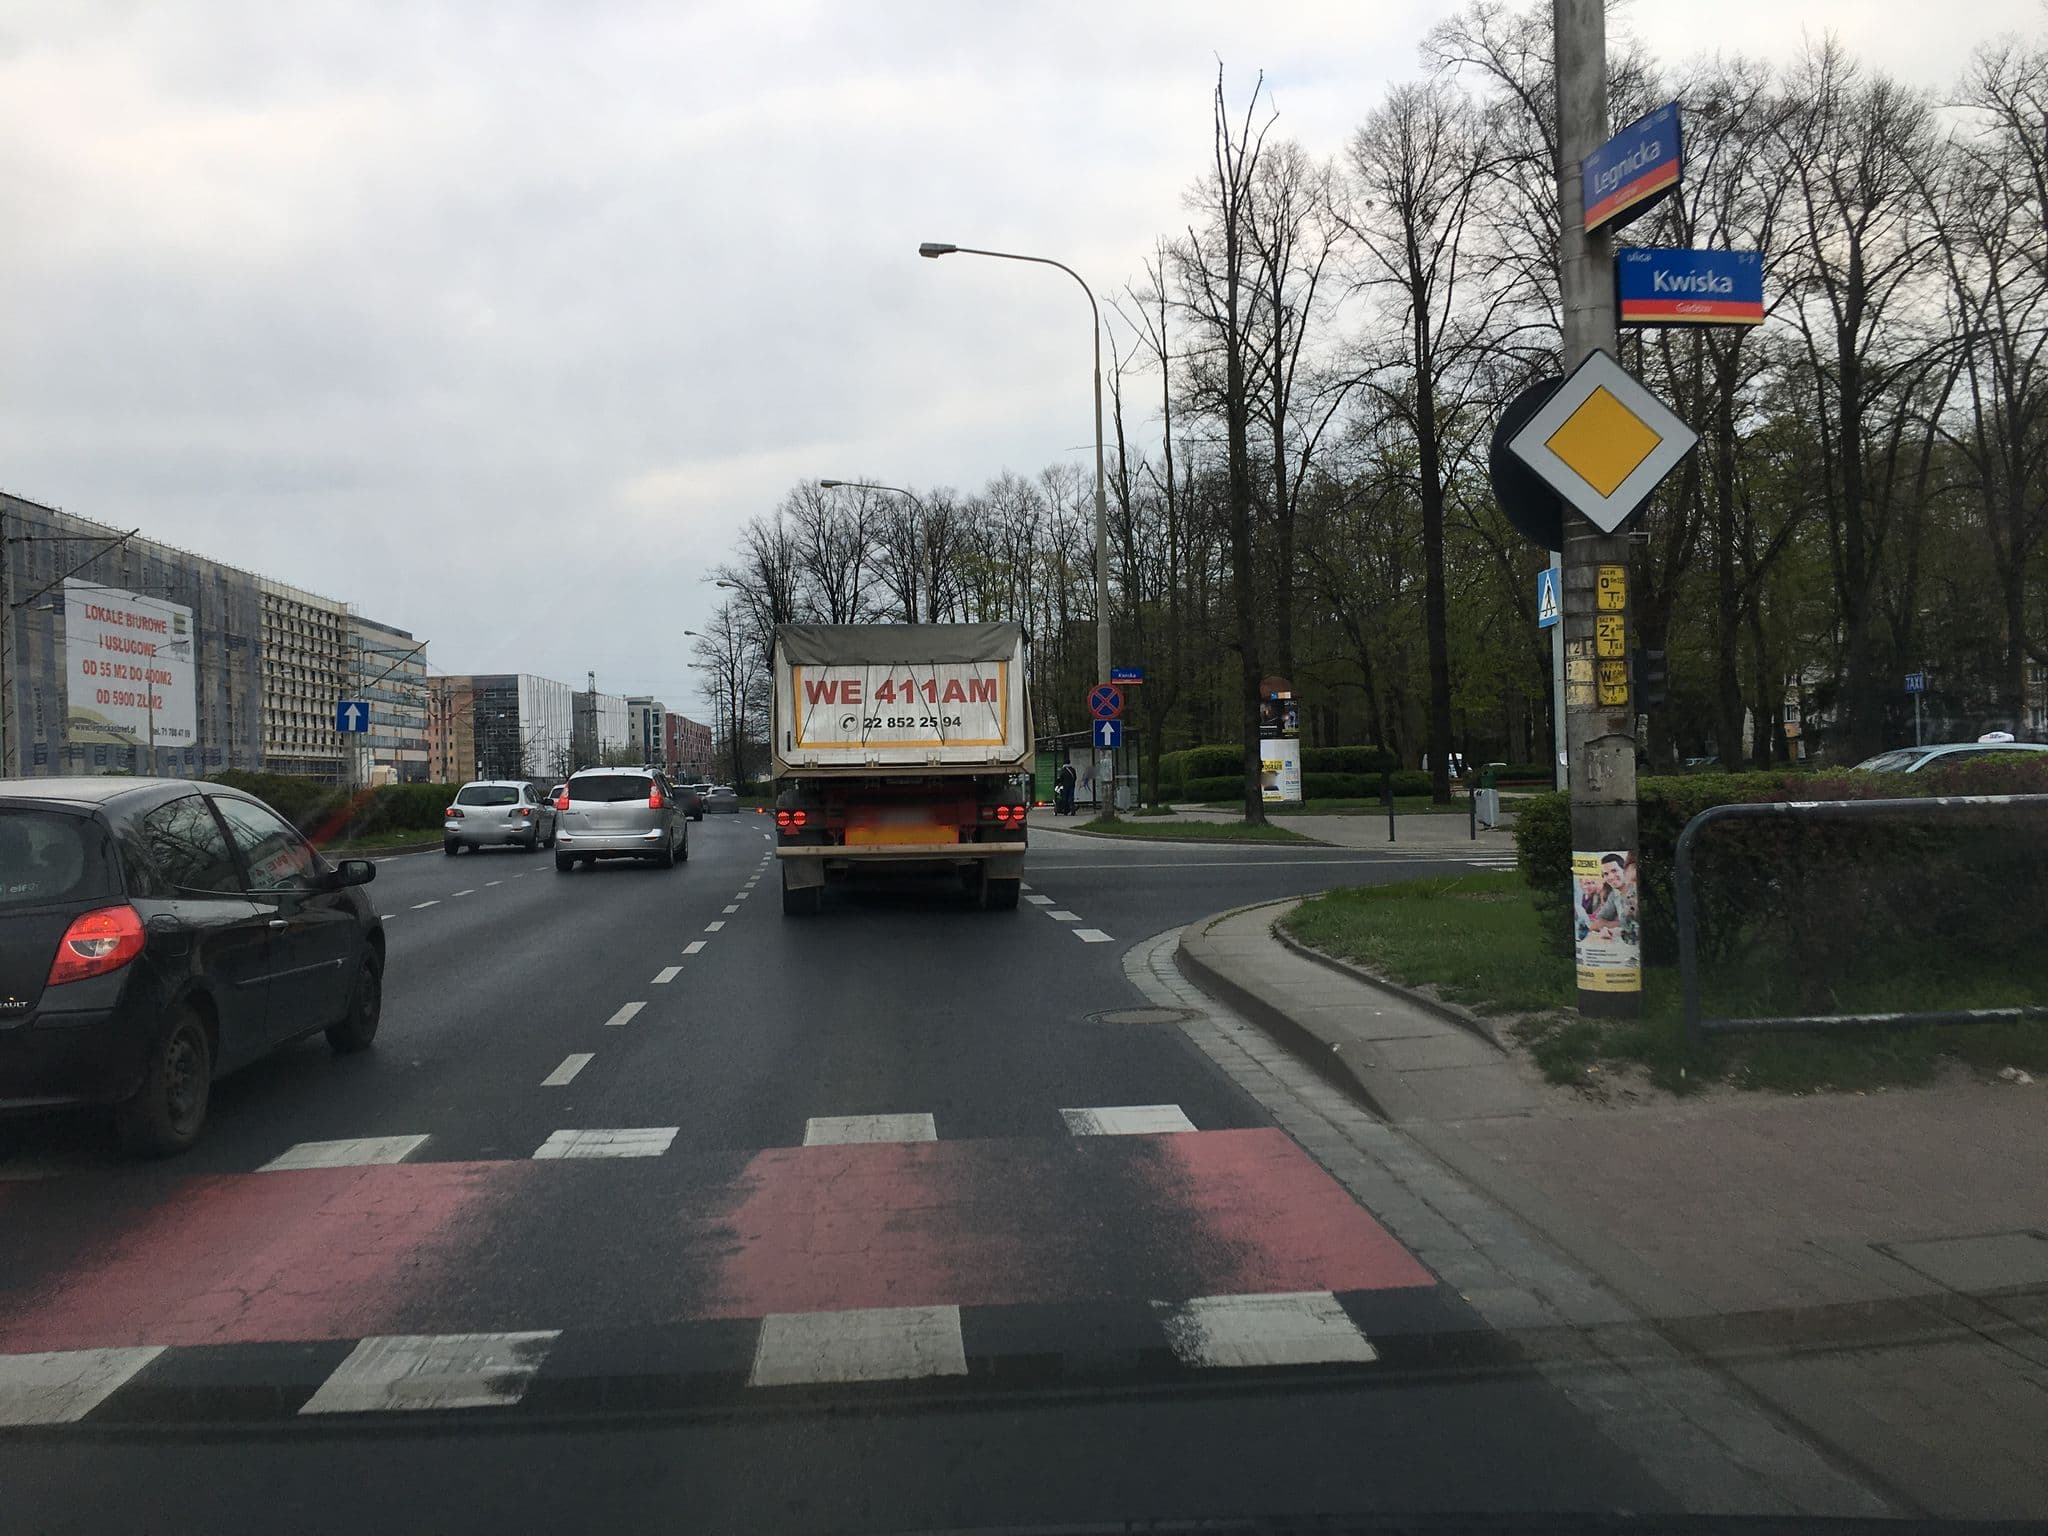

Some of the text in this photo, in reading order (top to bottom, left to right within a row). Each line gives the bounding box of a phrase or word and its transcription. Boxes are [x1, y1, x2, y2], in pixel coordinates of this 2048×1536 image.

[1594, 141, 1661, 194] Legnicka
[1653, 269, 1733, 293] Kwiska
[85, 604, 167, 635] LOKALE BIUROWE
[105, 636, 157, 657] USŁUGOWE
[82, 659, 97, 676] OD
[100, 663, 111, 677] 55
[114, 664, 127, 680] M2
[129, 667, 143, 681] DO
[805, 678, 997, 705] WE 411AM
[1905, 676, 1924, 690] TAXI
[96, 688, 110, 704] OD
[112, 692, 135, 707] 5900
[863, 716, 962, 729] 22 852 25 94
[0, 1000, 28, 1009] AULT
